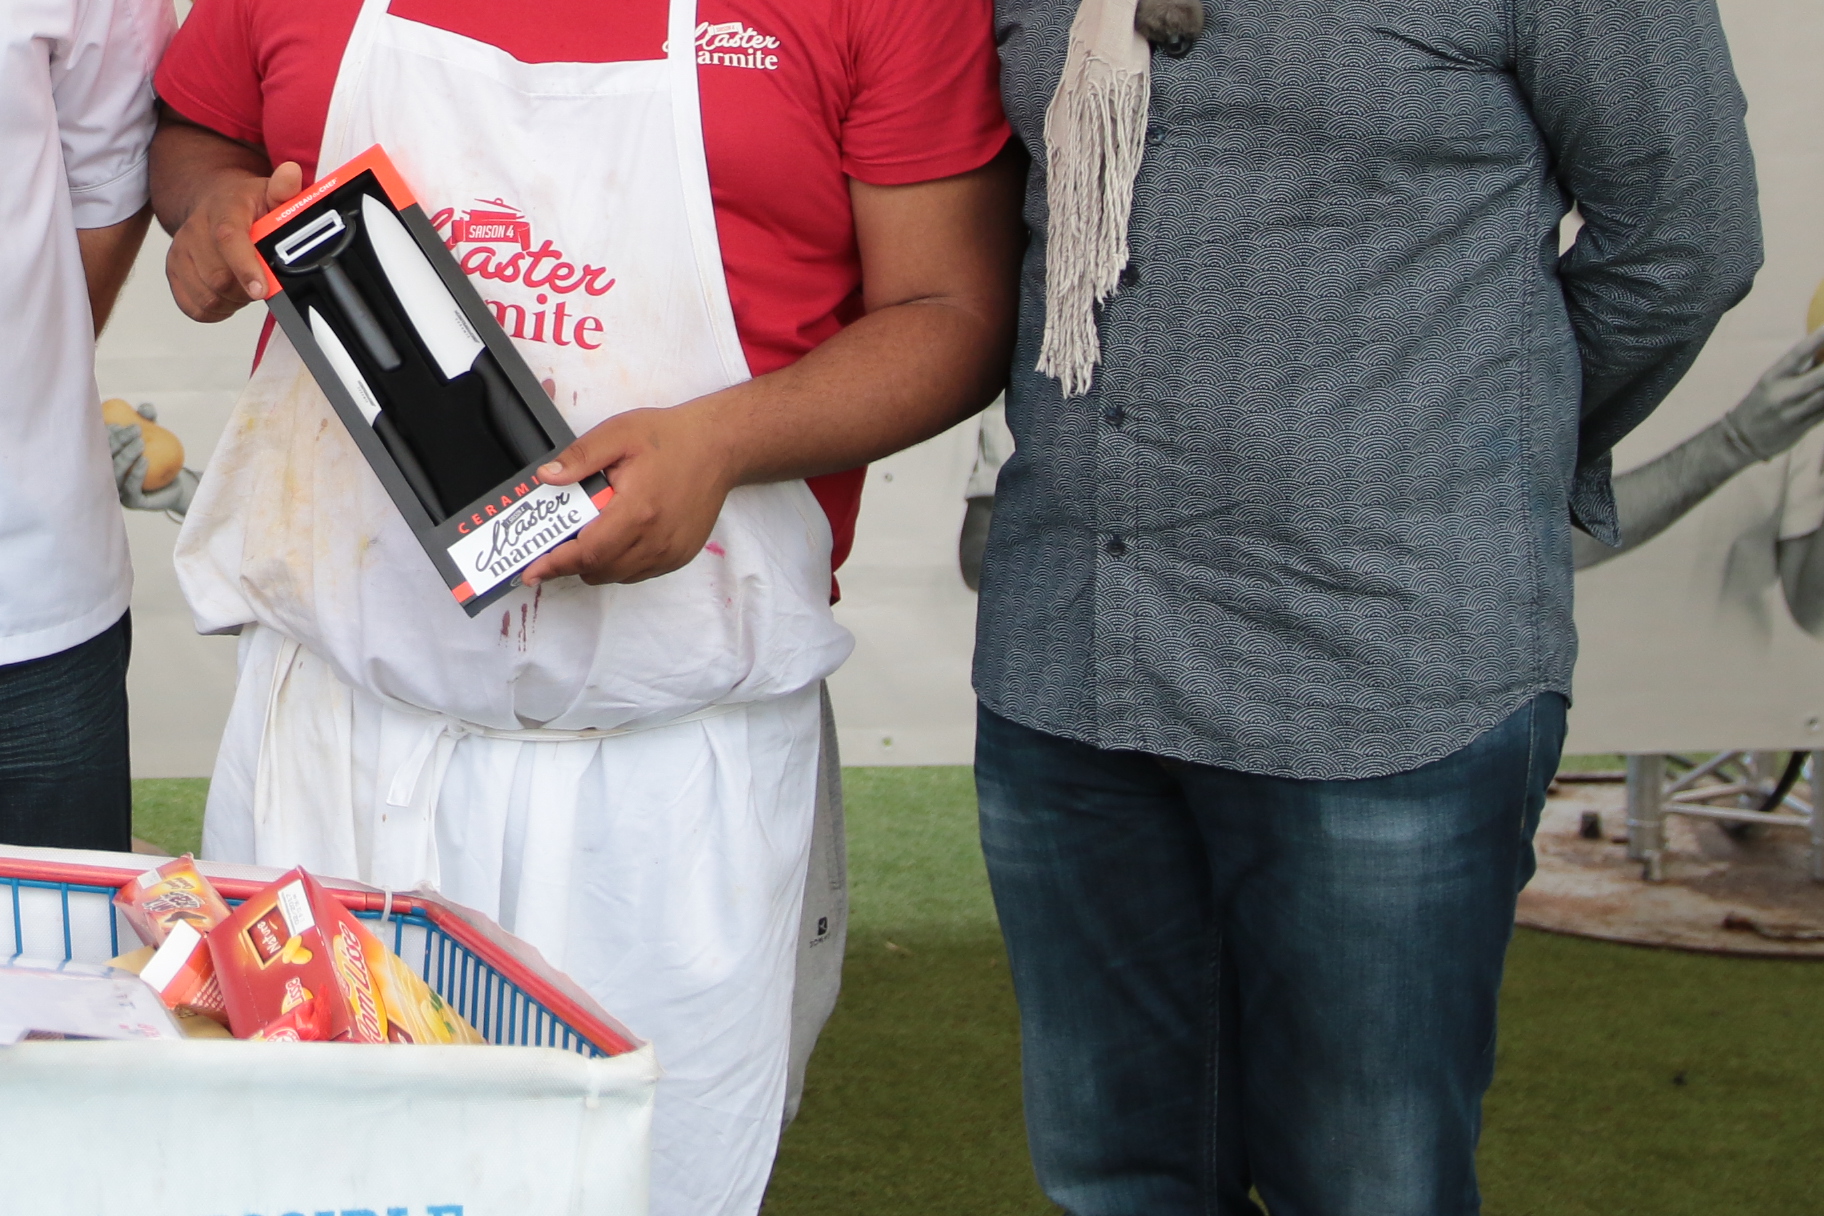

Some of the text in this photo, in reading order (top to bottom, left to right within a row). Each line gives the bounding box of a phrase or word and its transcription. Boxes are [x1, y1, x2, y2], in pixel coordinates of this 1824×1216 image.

[696, 48, 779, 70] armite
[281, 194, 313, 219] COUTEAU
[469, 224, 515, 239] SAISON 4
[484, 292, 605, 350] mite
[457, 475, 541, 534] CERAMI
[475, 491, 570, 572] Master
[489, 508, 582, 578] marmite
[256, 920, 281, 955] Nature
